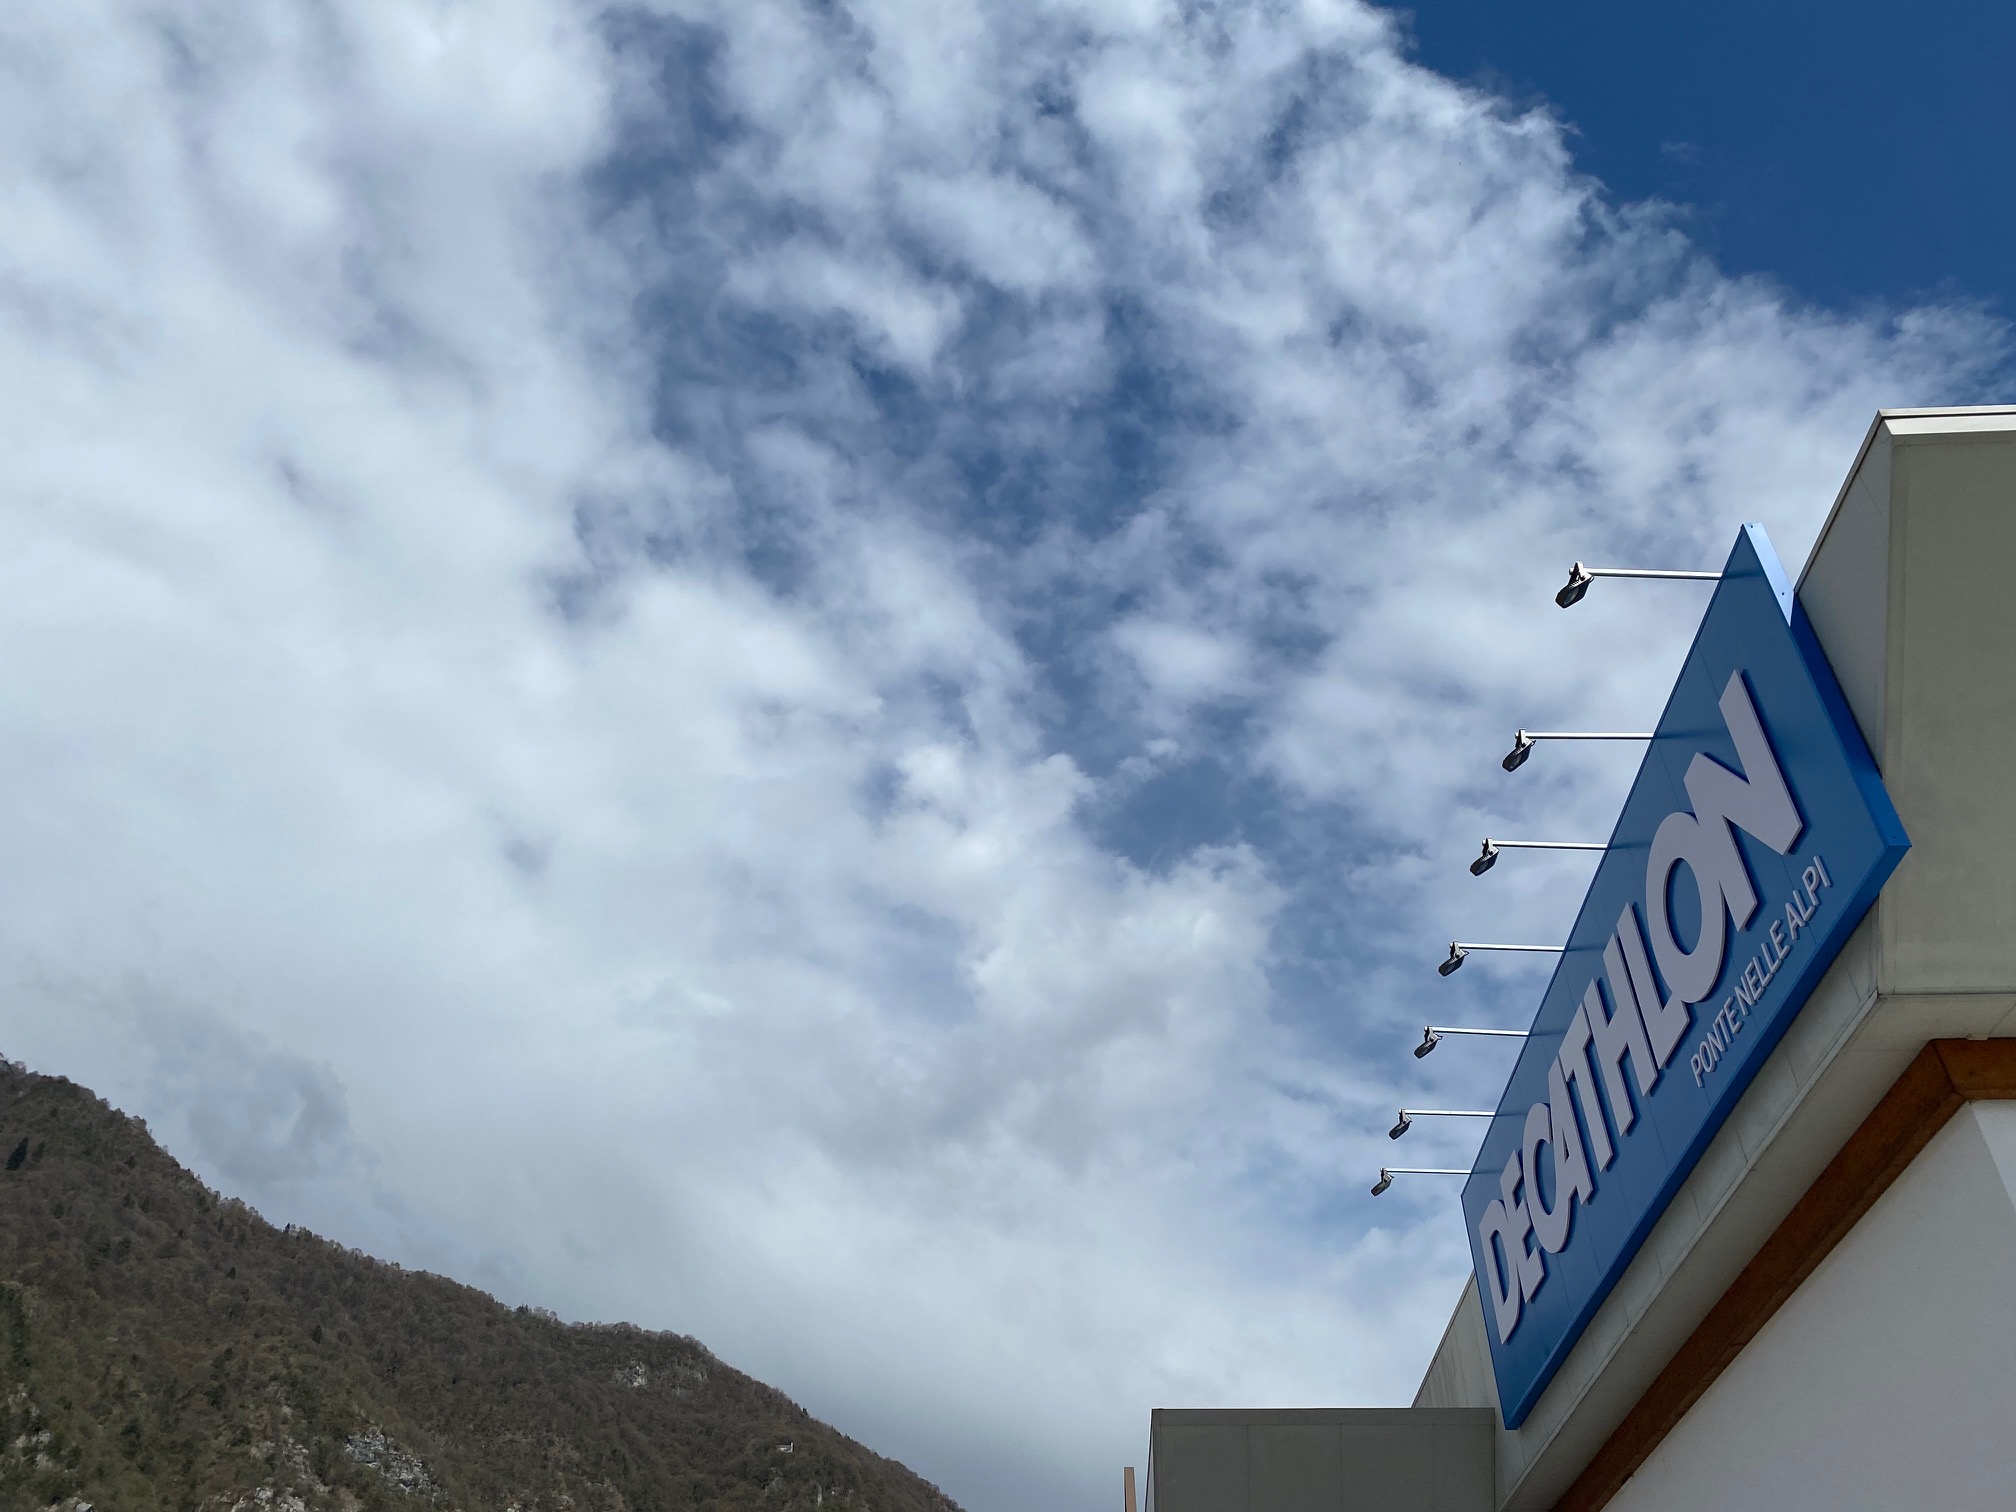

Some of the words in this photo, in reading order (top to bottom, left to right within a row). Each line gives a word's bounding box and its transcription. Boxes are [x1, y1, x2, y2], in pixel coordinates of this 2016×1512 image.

[1479, 669, 1803, 1344] DECATHLON
[1690, 996, 1742, 1088] PONTE
[1734, 919, 1791, 1016] NELLE
[1785, 855, 1831, 941] ALPI
